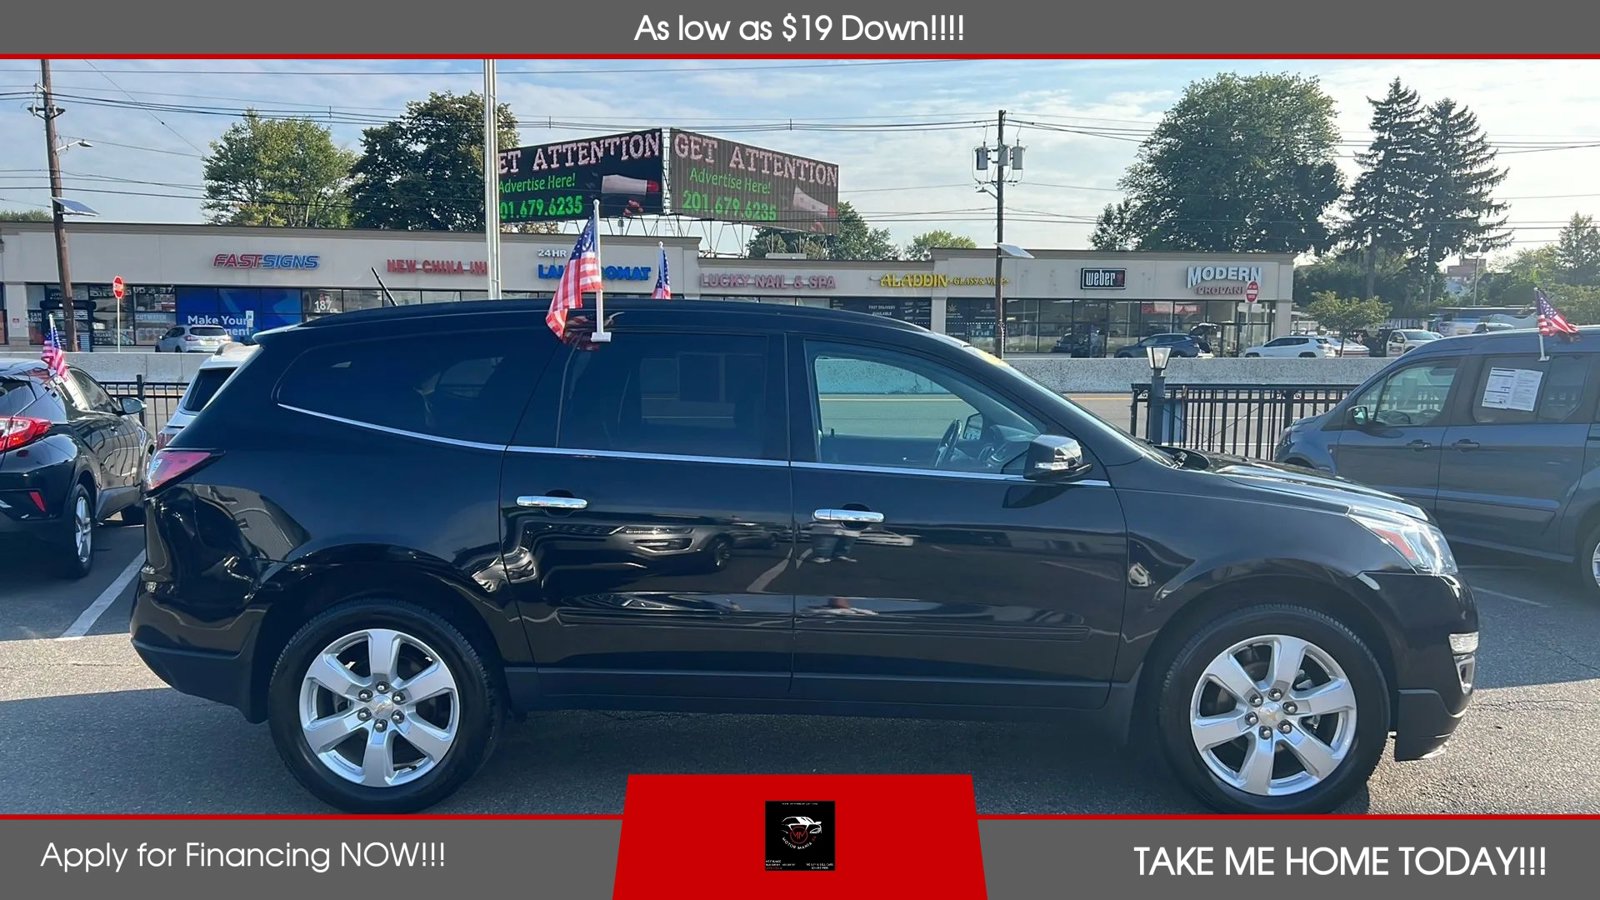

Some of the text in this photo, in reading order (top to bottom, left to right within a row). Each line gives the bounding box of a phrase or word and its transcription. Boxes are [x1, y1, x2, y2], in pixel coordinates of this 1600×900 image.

[498, 132, 661, 174] ET ATTENTION
[674, 132, 838, 187] GET ATTENTION
[499, 172, 576, 194] Advertise Here!
[689, 167, 771, 194] Advertise Here!
[500, 195, 583, 219] 01.679.6235
[682, 190, 777, 221] 201.679.6235
[213, 253, 321, 270] FASTSIGNS
[552, 249, 567, 258] HR
[387, 259, 416, 273] NEW
[422, 259, 464, 275] CHINA
[538, 264, 652, 281] LAOMAT
[700, 272, 836, 290] LUCKY NAIL & SPA
[880, 273, 949, 288] ALADDIN
[1085, 269, 1116, 286] weber
[1187, 266, 1263, 289] MODERN
[1196, 285, 1244, 295] PROPAN
[314, 300, 332, 311] 187
[187, 315, 247, 325] Make Your
